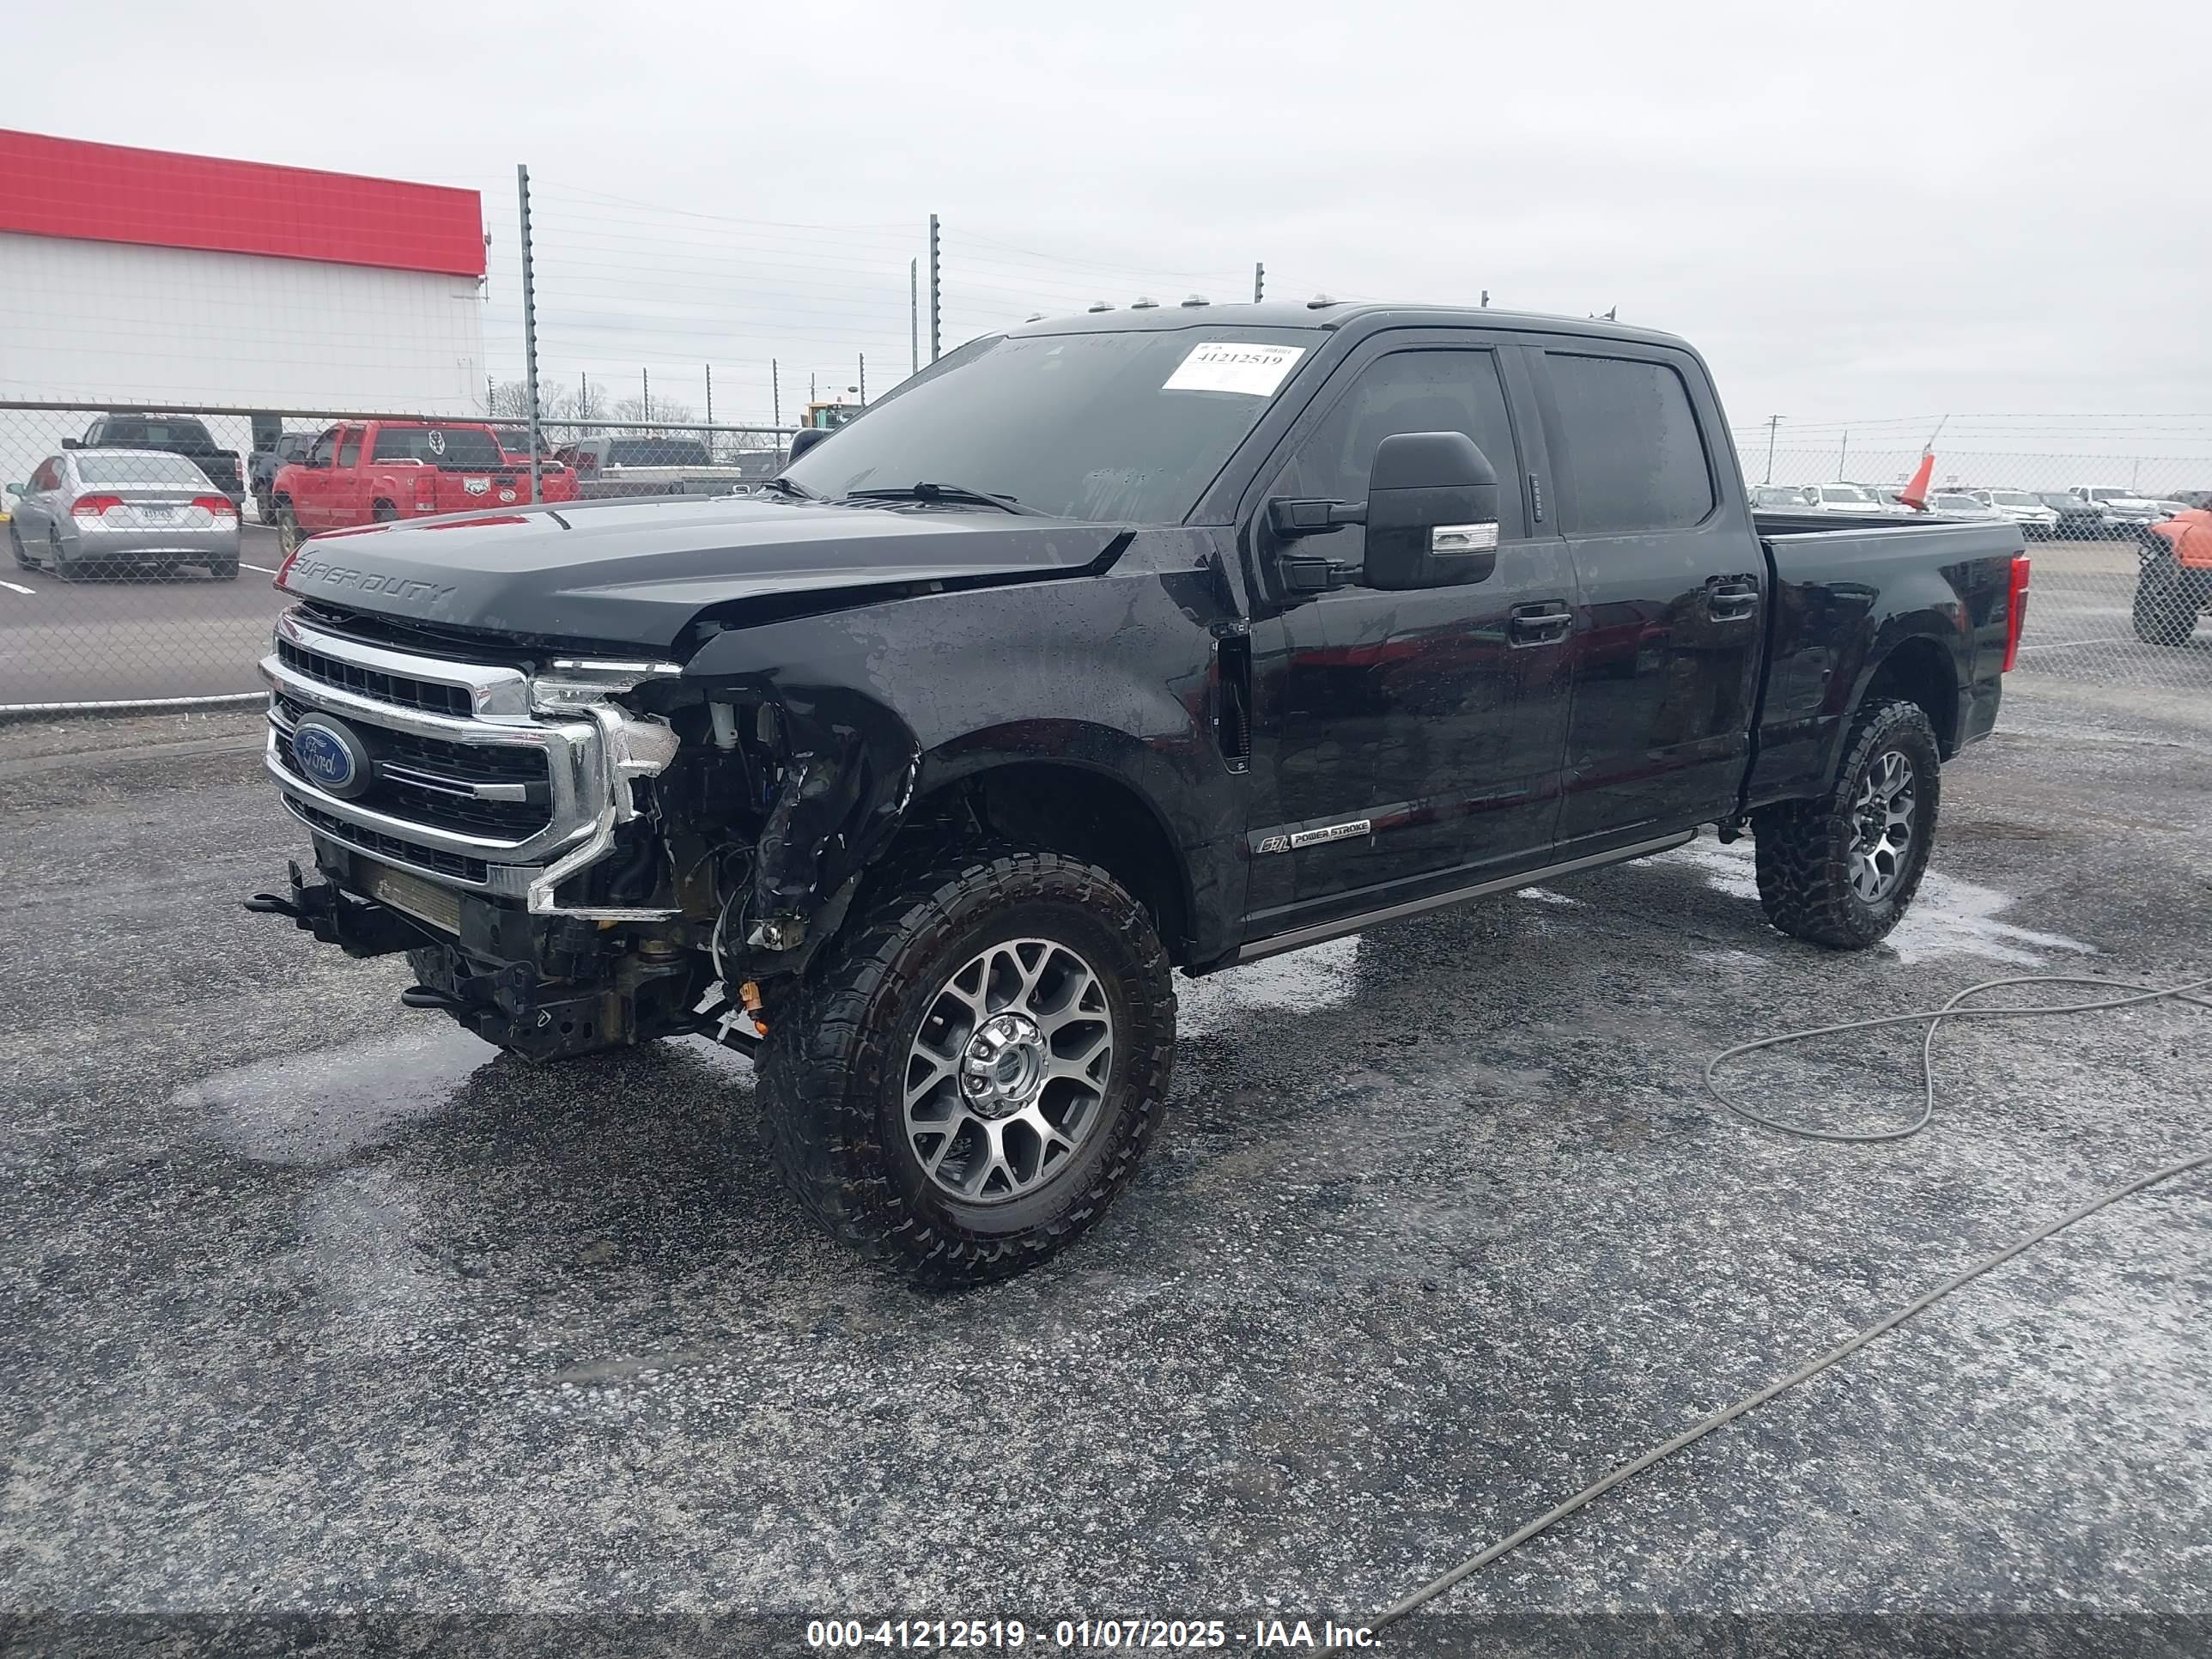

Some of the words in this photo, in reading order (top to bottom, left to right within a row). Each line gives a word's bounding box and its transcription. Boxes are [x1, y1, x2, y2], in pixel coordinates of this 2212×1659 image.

[1197, 352, 1283, 365] 41212519
[289, 550, 359, 586] SUPER
[359, 574, 457, 602] DUTY
[302, 734, 337, 776] Ford
[1295, 830, 1329, 843] POWER
[1330, 822, 1369, 836] STROKE
